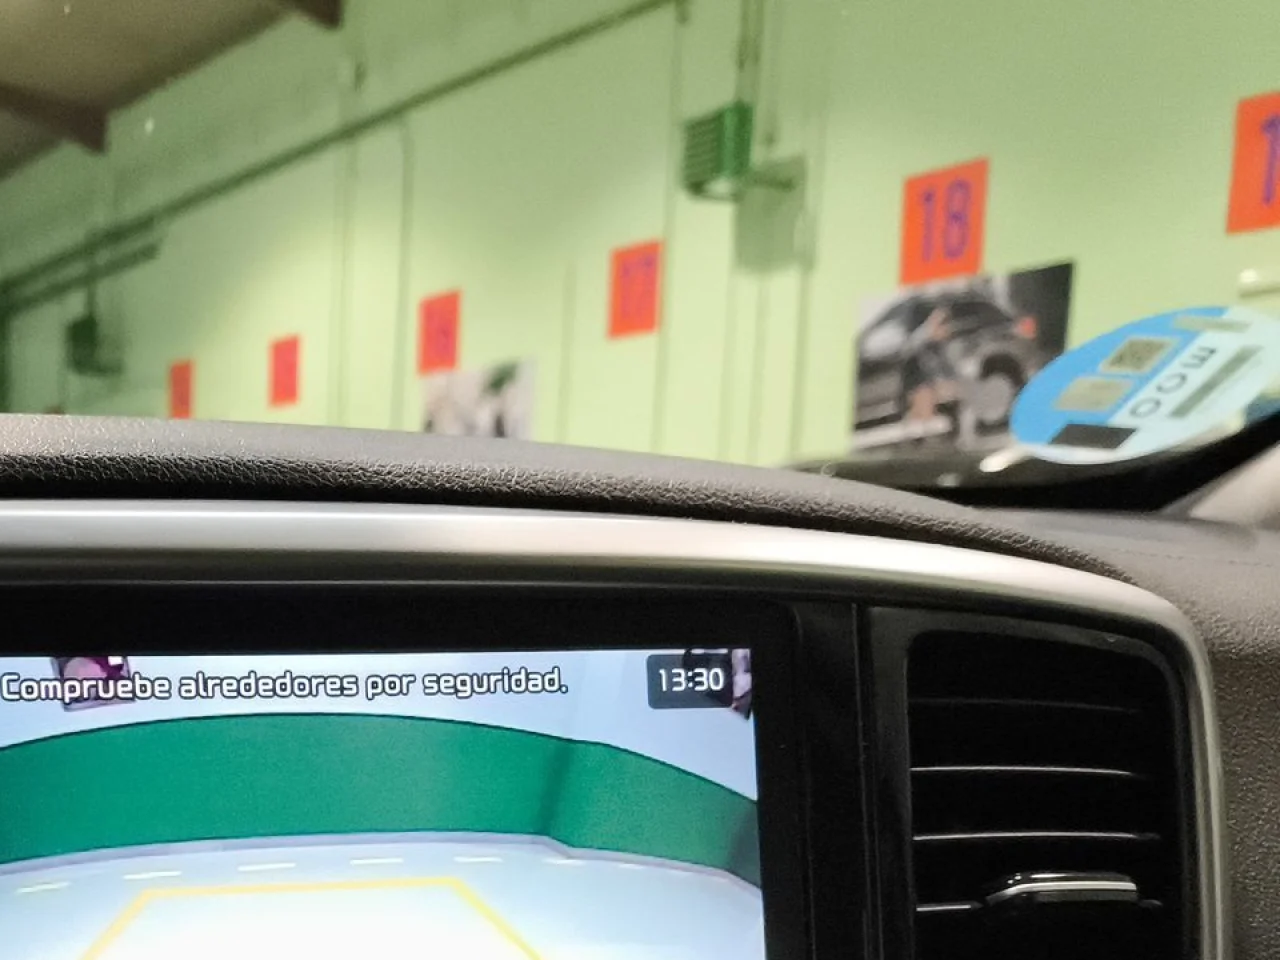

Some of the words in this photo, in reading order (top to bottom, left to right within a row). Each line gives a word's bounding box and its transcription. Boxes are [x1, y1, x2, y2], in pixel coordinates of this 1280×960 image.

[920, 179, 972, 262] 18
[0, 671, 171, 702] Compruebe
[178, 670, 358, 698] alrededores
[365, 674, 416, 700] por
[423, 667, 568, 699] seguridad.
[659, 668, 725, 692] 13:30
